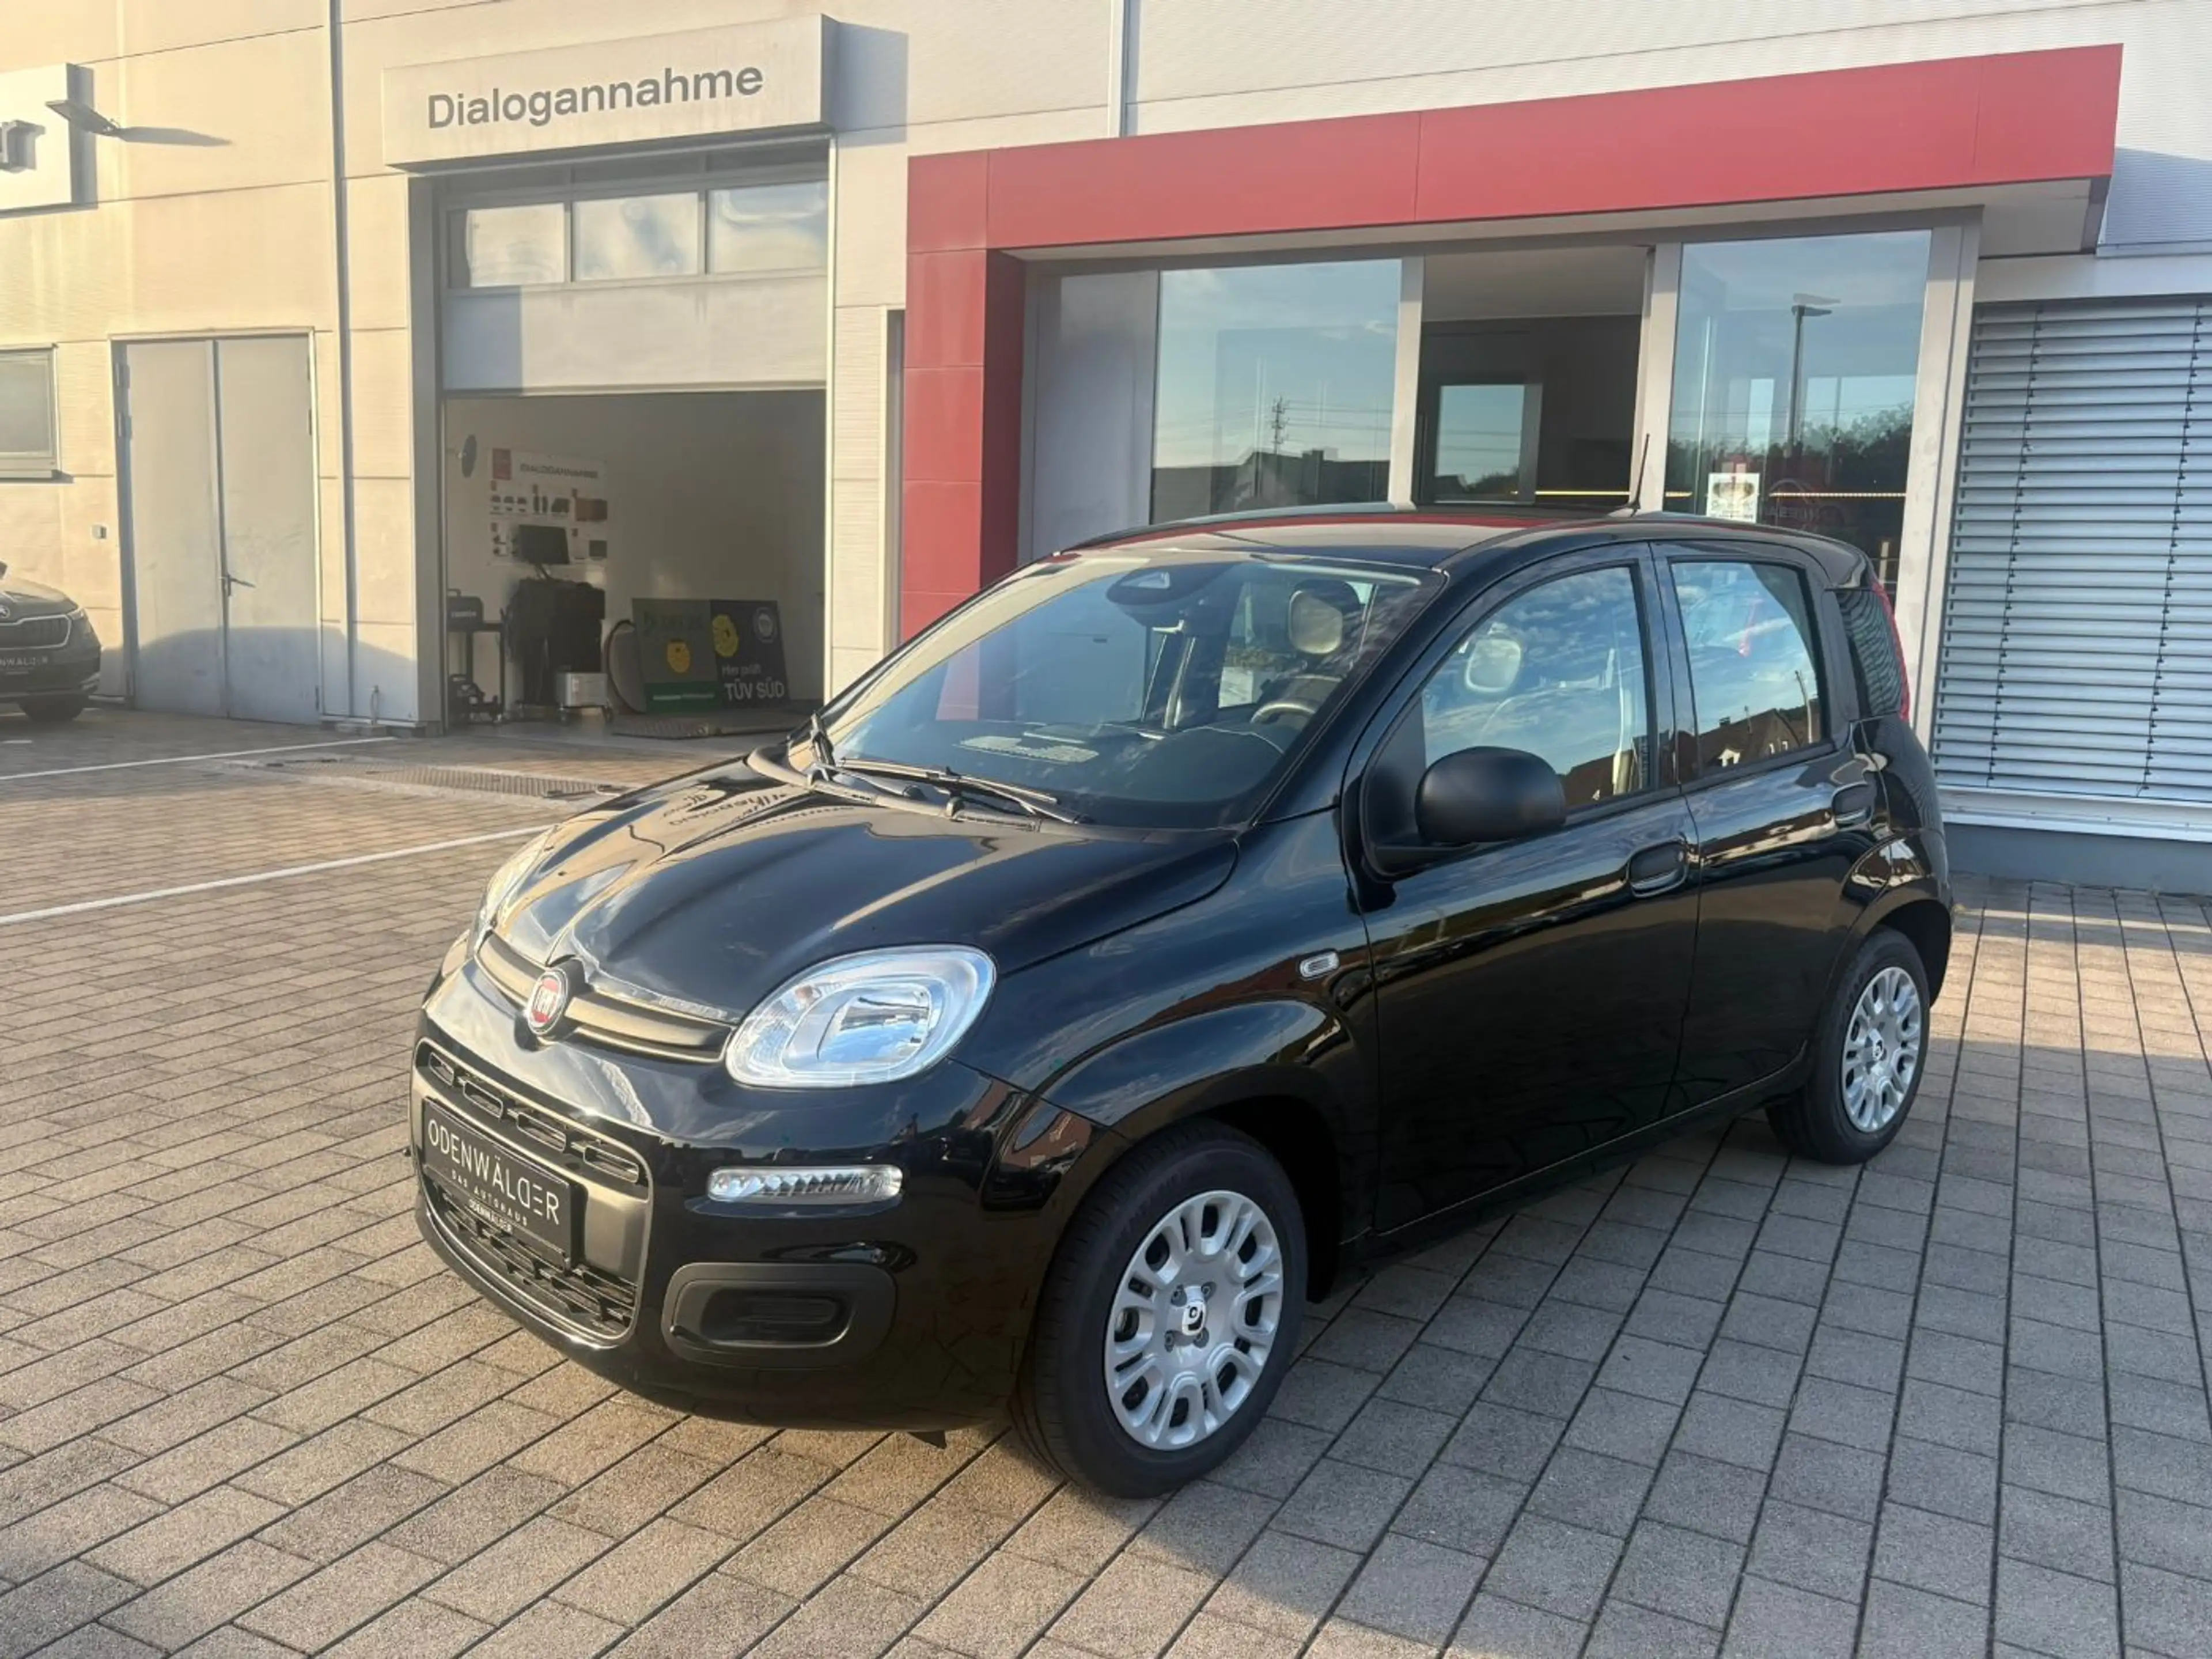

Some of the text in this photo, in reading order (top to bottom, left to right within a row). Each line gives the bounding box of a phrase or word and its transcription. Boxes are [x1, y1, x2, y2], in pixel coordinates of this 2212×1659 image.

[428, 66, 764, 128] Dialogannahme
[724, 676, 785, 701] TÜV SÜD
[428, 1119, 559, 1225] ODENWÄLDER
[474, 1185, 527, 1226] AUTOHAUS
